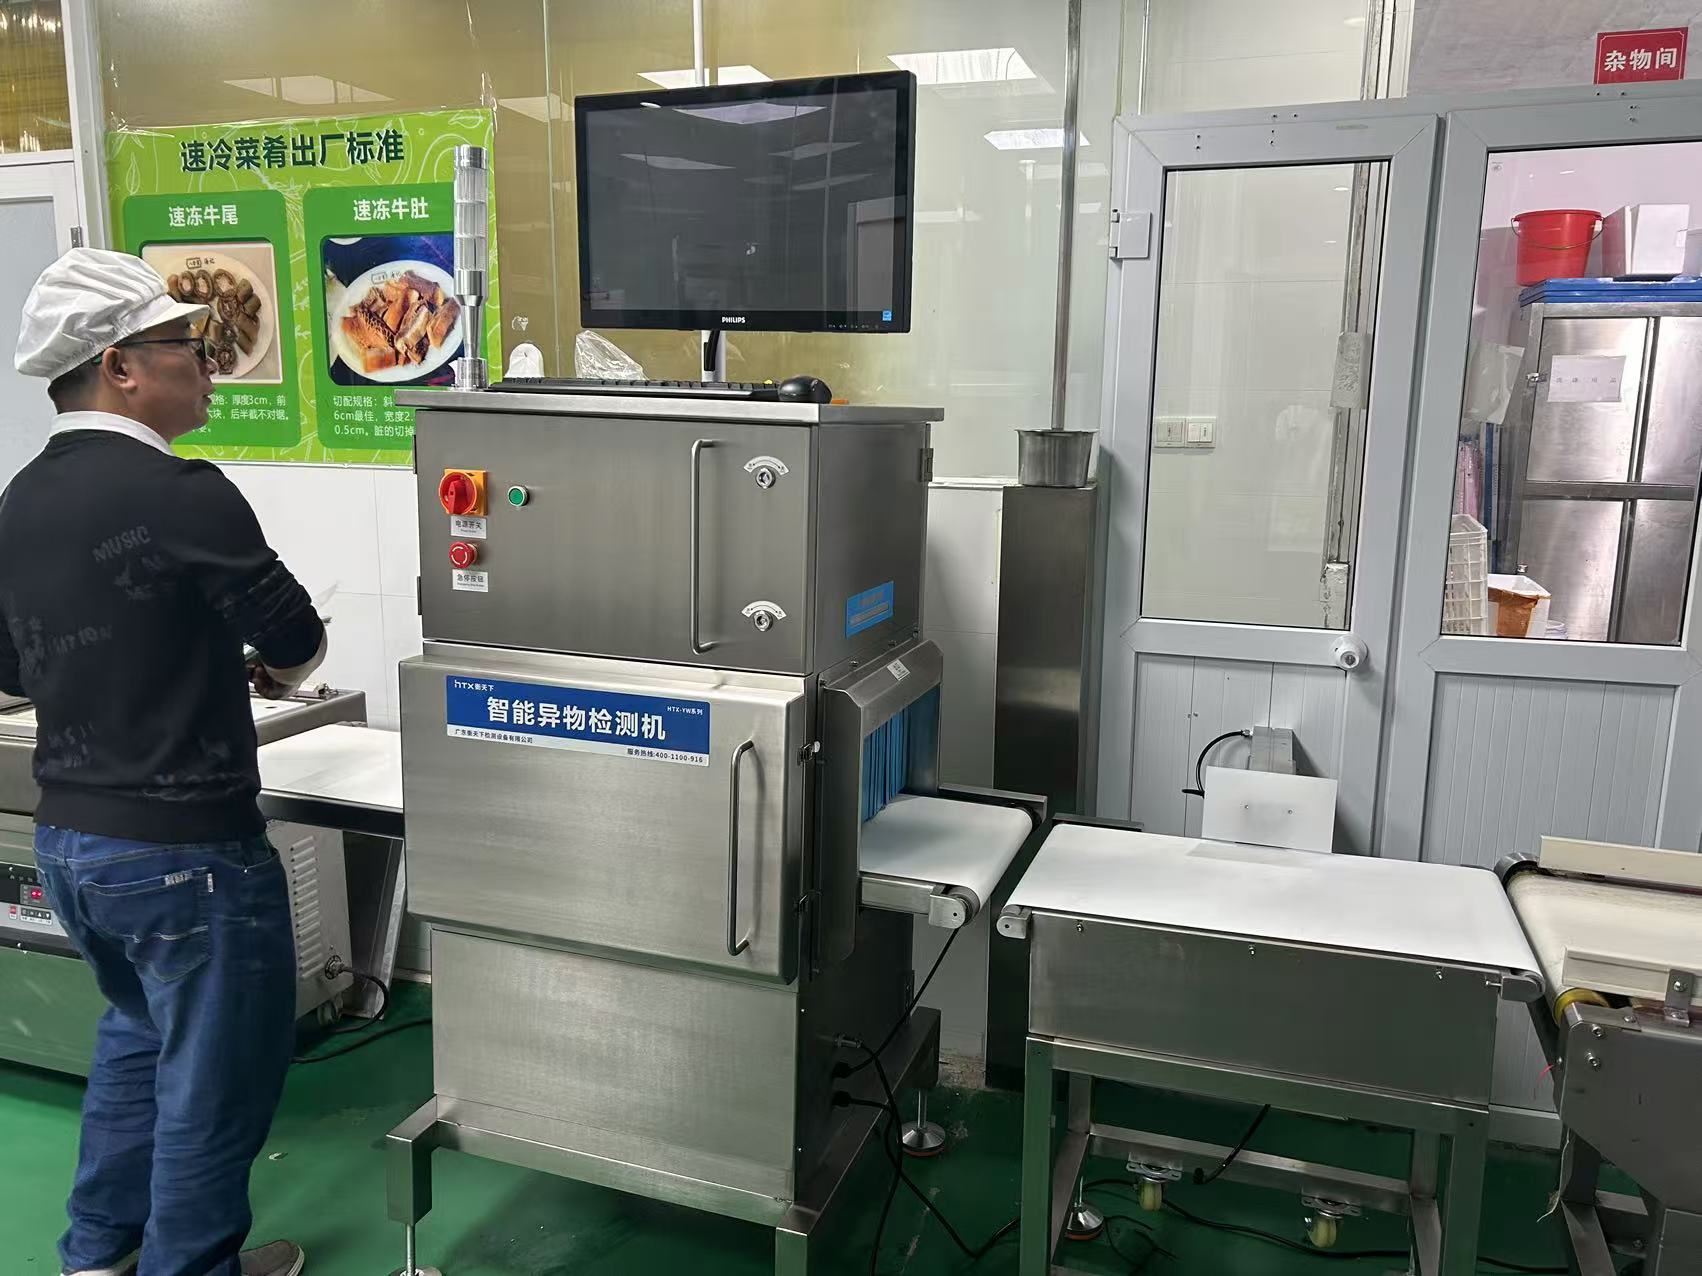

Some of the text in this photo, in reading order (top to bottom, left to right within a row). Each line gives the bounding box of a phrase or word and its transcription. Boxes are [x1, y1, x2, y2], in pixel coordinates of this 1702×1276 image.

[1604, 47, 1677, 72] 杂物间
[179, 129, 405, 172] 速冷菜肴出厂标准
[168, 204, 239, 227] 速冻牛尾
[353, 197, 429, 221] 速冻牛肚
[721, 316, 746, 324] PHILIPS
[455, 520, 482, 529] 电源开关
[92, 526, 151, 562] MUSIC
[457, 574, 484, 583] 急停按钮
[487, 696, 666, 740] 智能异物检测机
